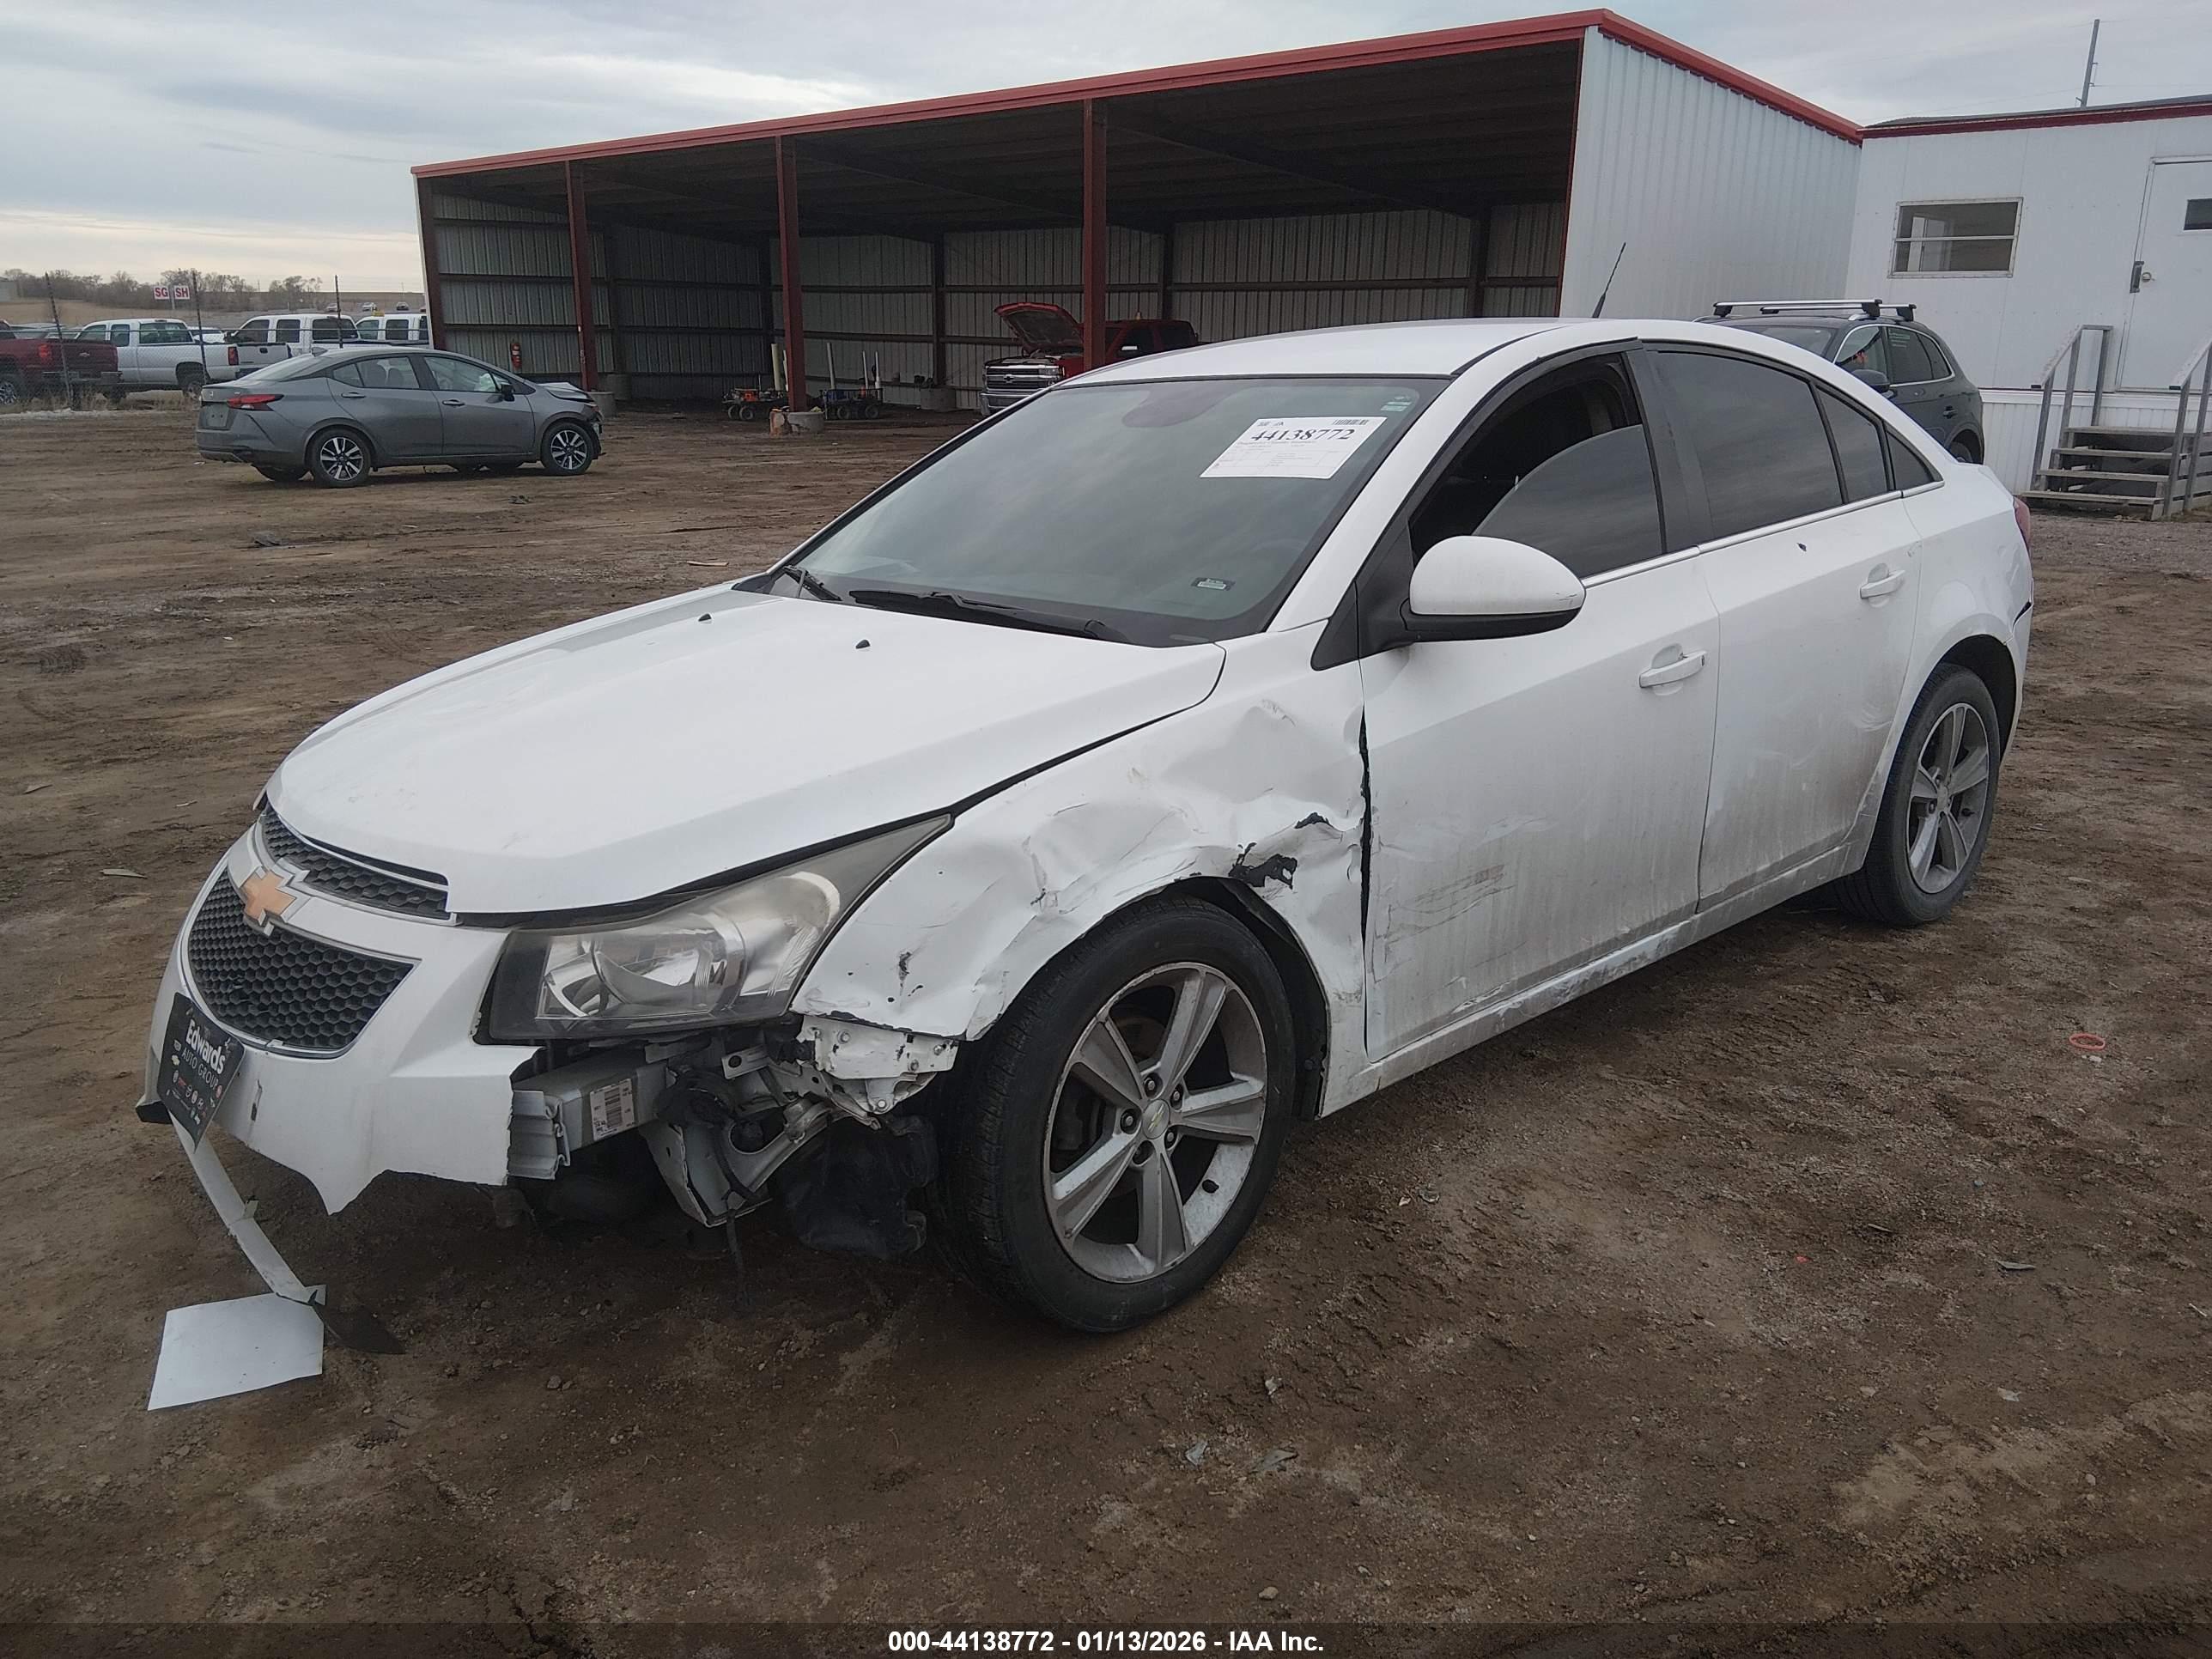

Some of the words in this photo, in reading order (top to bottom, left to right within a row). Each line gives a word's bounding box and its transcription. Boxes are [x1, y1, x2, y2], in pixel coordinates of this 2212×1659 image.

[155, 287, 168, 297] SG
[175, 287, 189, 297] SH
[1250, 428, 1355, 441] 44138772
[185, 1018, 226, 1074] Edwards
[181, 1047, 198, 1069] AUTO
[198, 1063, 219, 1091] GROUP
